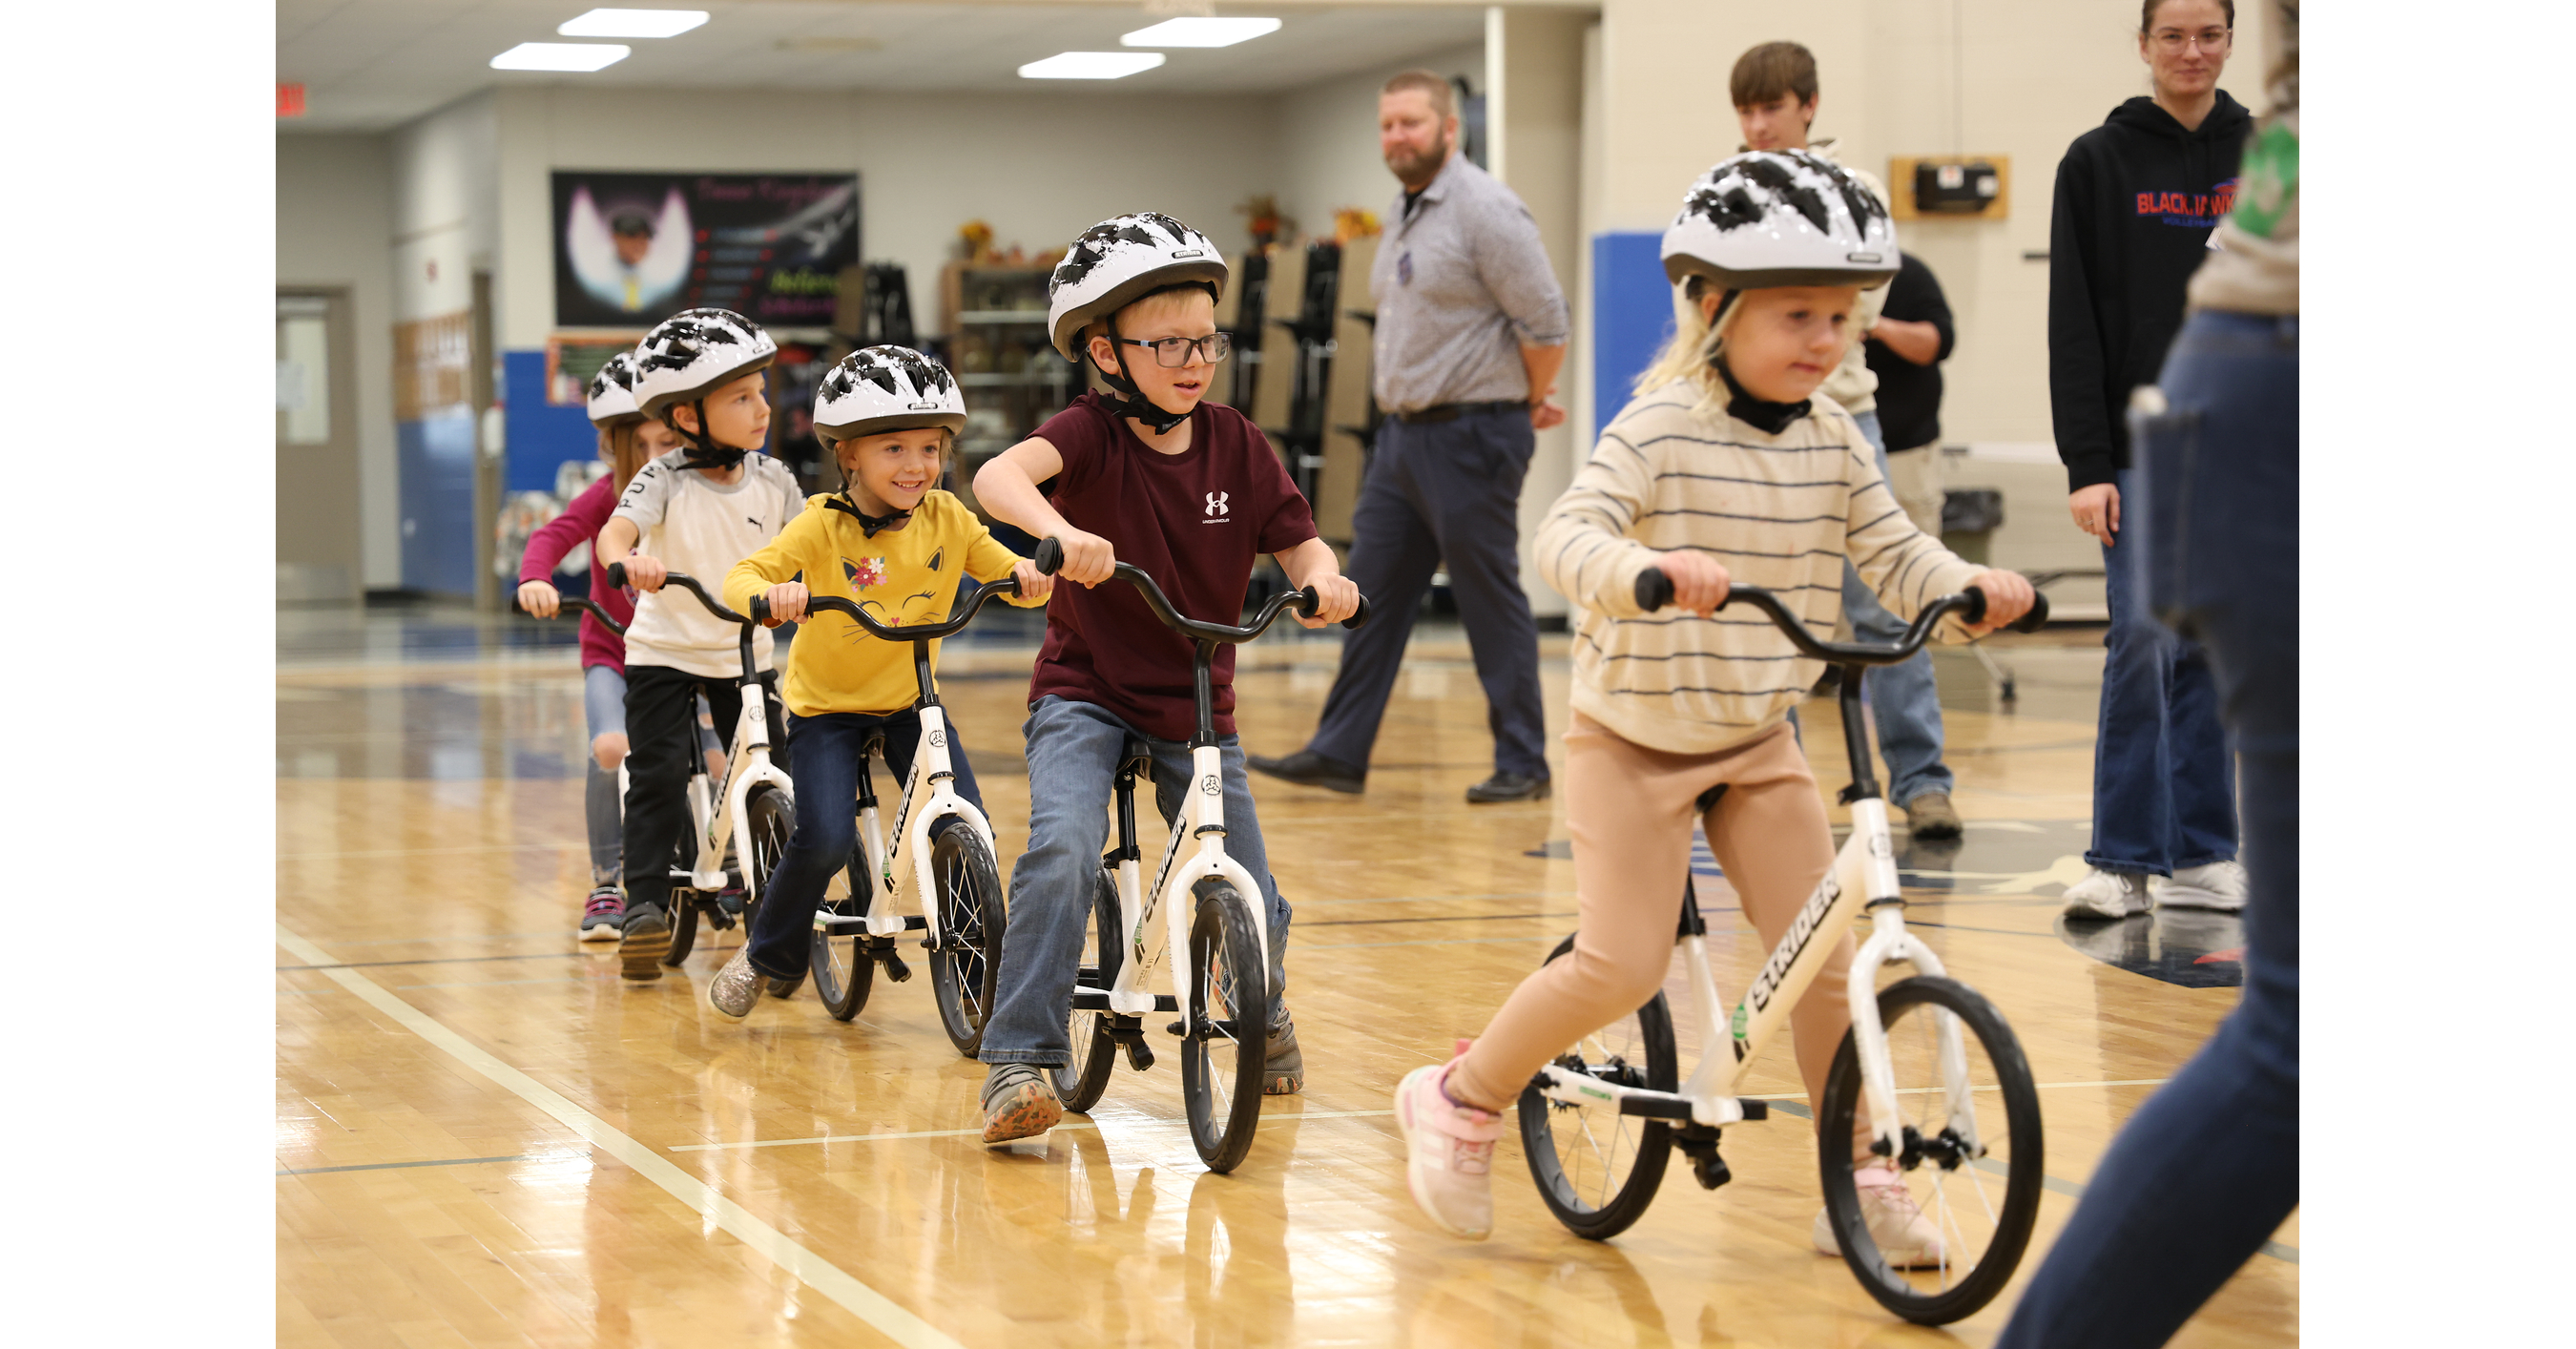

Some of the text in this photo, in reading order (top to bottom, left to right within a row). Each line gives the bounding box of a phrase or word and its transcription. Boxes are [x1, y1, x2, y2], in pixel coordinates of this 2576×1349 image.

[2136, 192, 2235, 217] BLACKHAWK
[1144, 811, 1187, 924] STRIDER
[1751, 867, 1840, 1012] STRIDER
